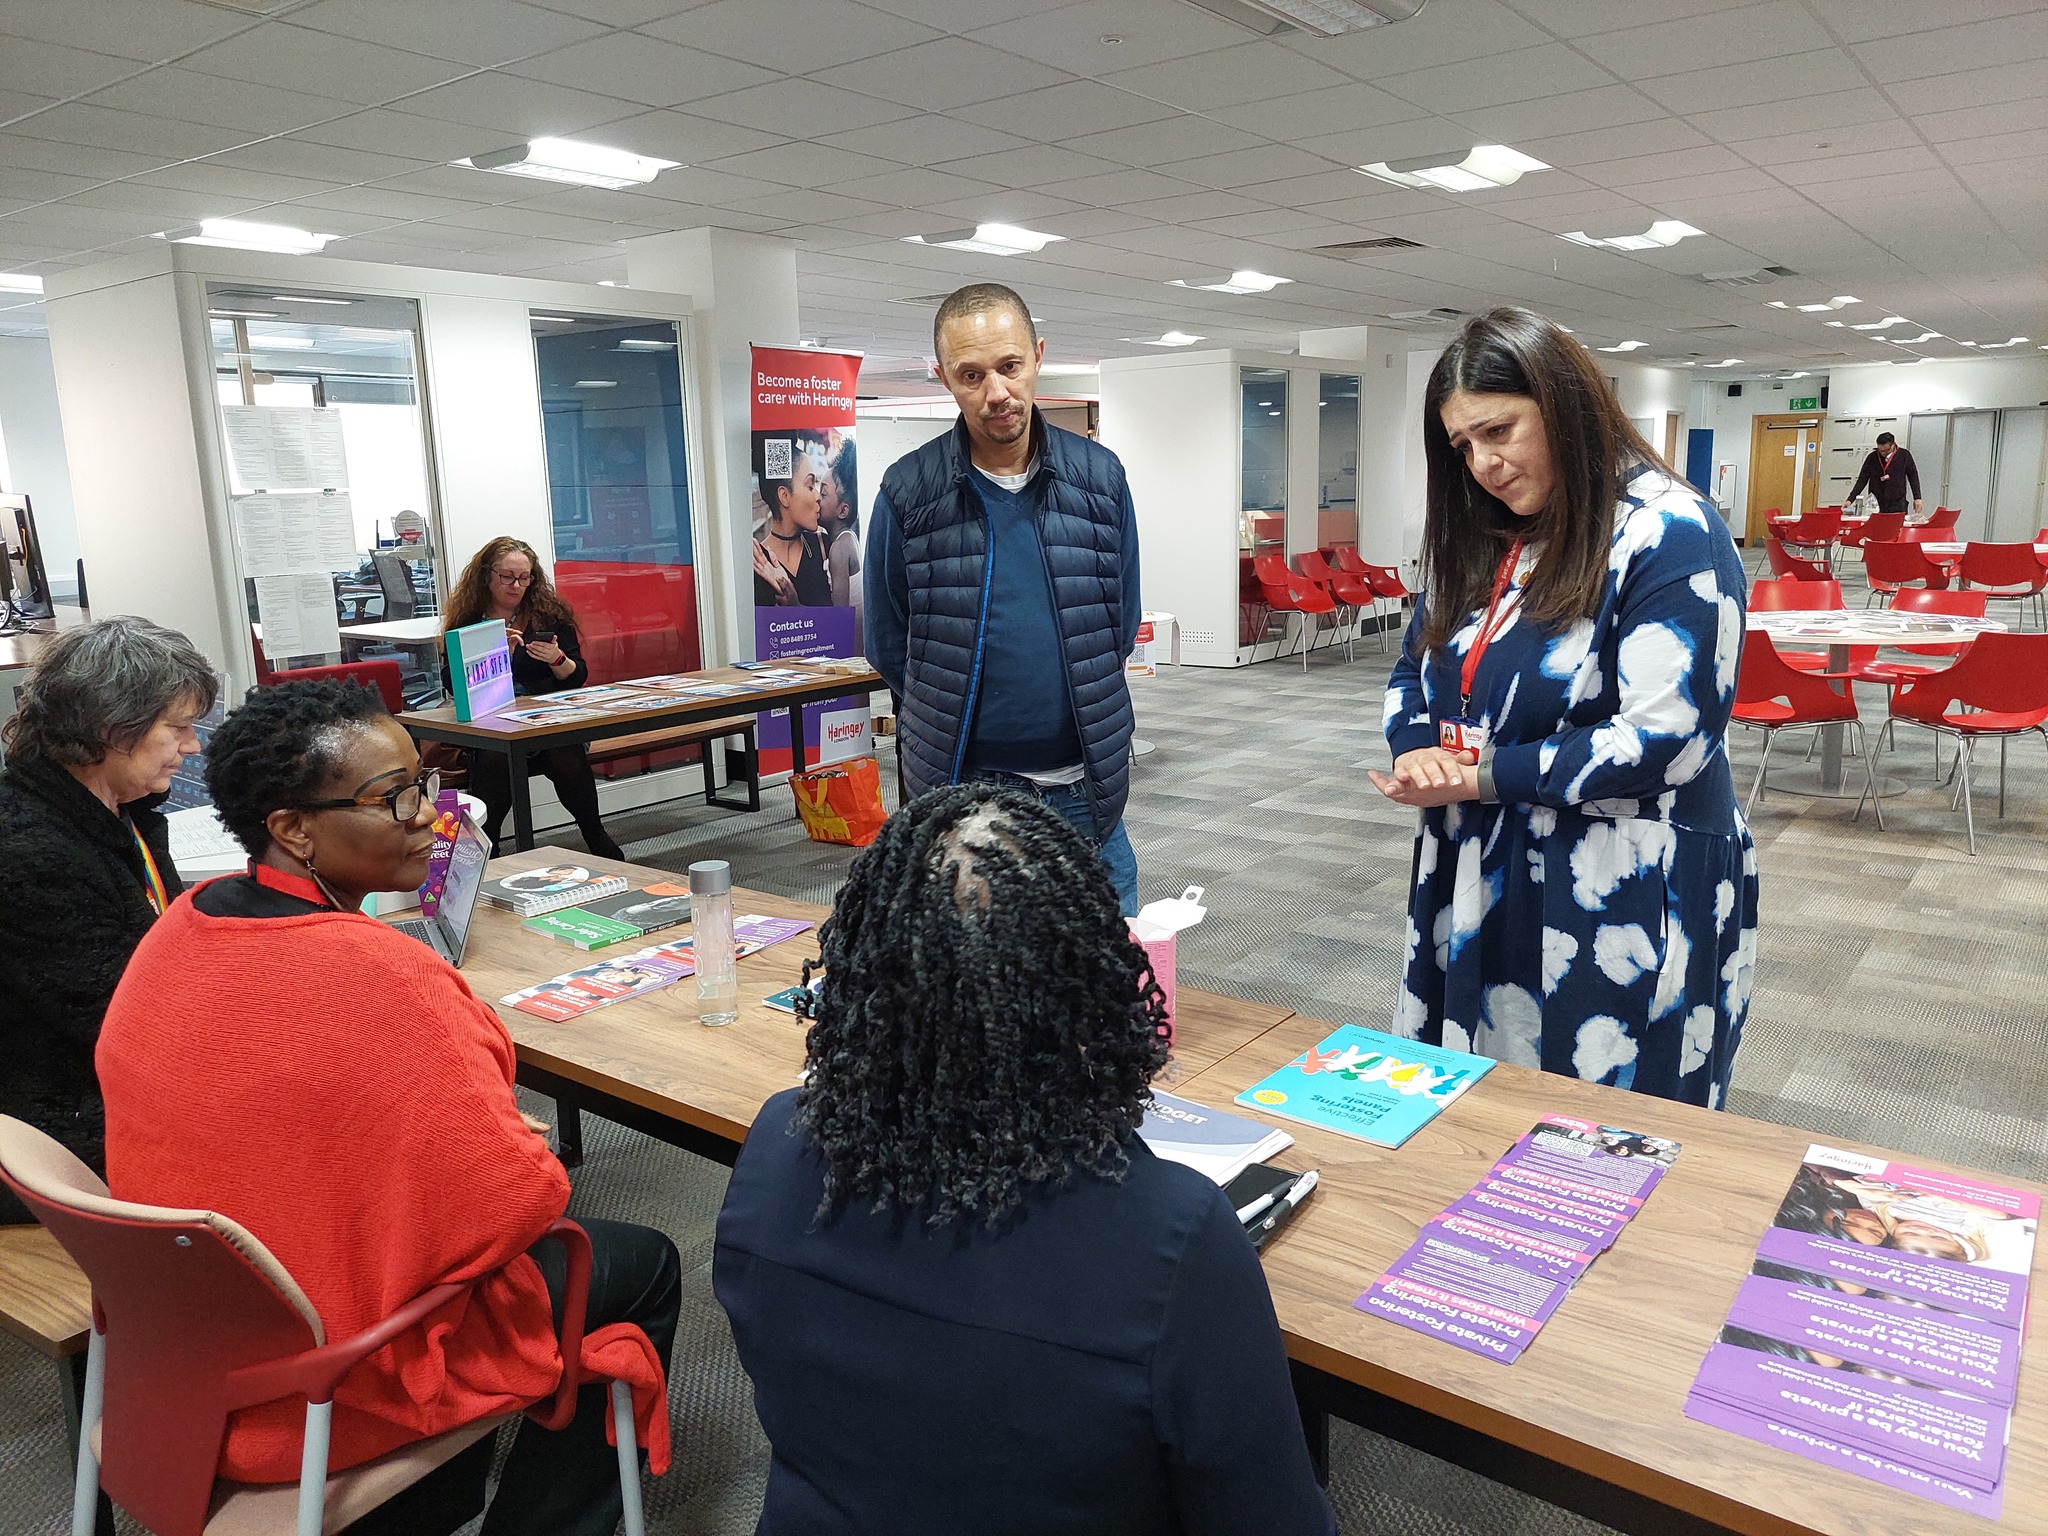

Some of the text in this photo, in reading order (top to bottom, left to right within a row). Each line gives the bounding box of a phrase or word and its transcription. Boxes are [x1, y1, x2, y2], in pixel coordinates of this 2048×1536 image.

[757, 372, 841, 390] Become a foster
[758, 392, 853, 411] carer with Haringey
[769, 620, 814, 632] Contact us
[804, 633, 817, 641] 3754
[781, 644, 835, 657] fosteringrecruitment
[490, 654, 510, 675] STEP
[828, 721, 865, 742] Haringey
[430, 851, 450, 859] reet
[432, 841, 452, 850] ality
[541, 916, 576, 930] Caring
[574, 927, 603, 939] Safer
[610, 932, 640, 944] Safer Caring
[1309, 1094, 1383, 1119] Fostering
[1341, 1095, 1391, 1112] Panels
[1317, 1106, 1375, 1126] Effective
[1498, 1171, 1571, 1195] Fostering
[1505, 1166, 1550, 1181] mean?
[1484, 1183, 1557, 1209] Fostering
[1560, 1180, 1594, 1192] does
[1590, 1188, 1630, 1202] What
[1473, 1195, 1547, 1221] Fostering
[1569, 1191, 1626, 1211] Private
[1555, 1204, 1612, 1225] Private
[1439, 1221, 1514, 1250] Fostering
[1447, 1215, 1578, 1259] What does it mean?
[1545, 1216, 1604, 1237] Private
[1512, 1245, 1571, 1268] Private
[1827, 1258, 2006, 1312] You may be a private
[1886, 1267, 2007, 1304] foster carer if
[1379, 1283, 1521, 1338] Private Fostering
[1388, 1277, 1527, 1326] What does it mean?
[1443, 1324, 1507, 1352] Private
[1808, 1312, 1997, 1374] You may be a private
[1870, 1322, 1999, 1365] foster carer if
[1778, 1388, 1982, 1461] You may be a private
[1845, 1400, 1984, 1450] foster carer if
